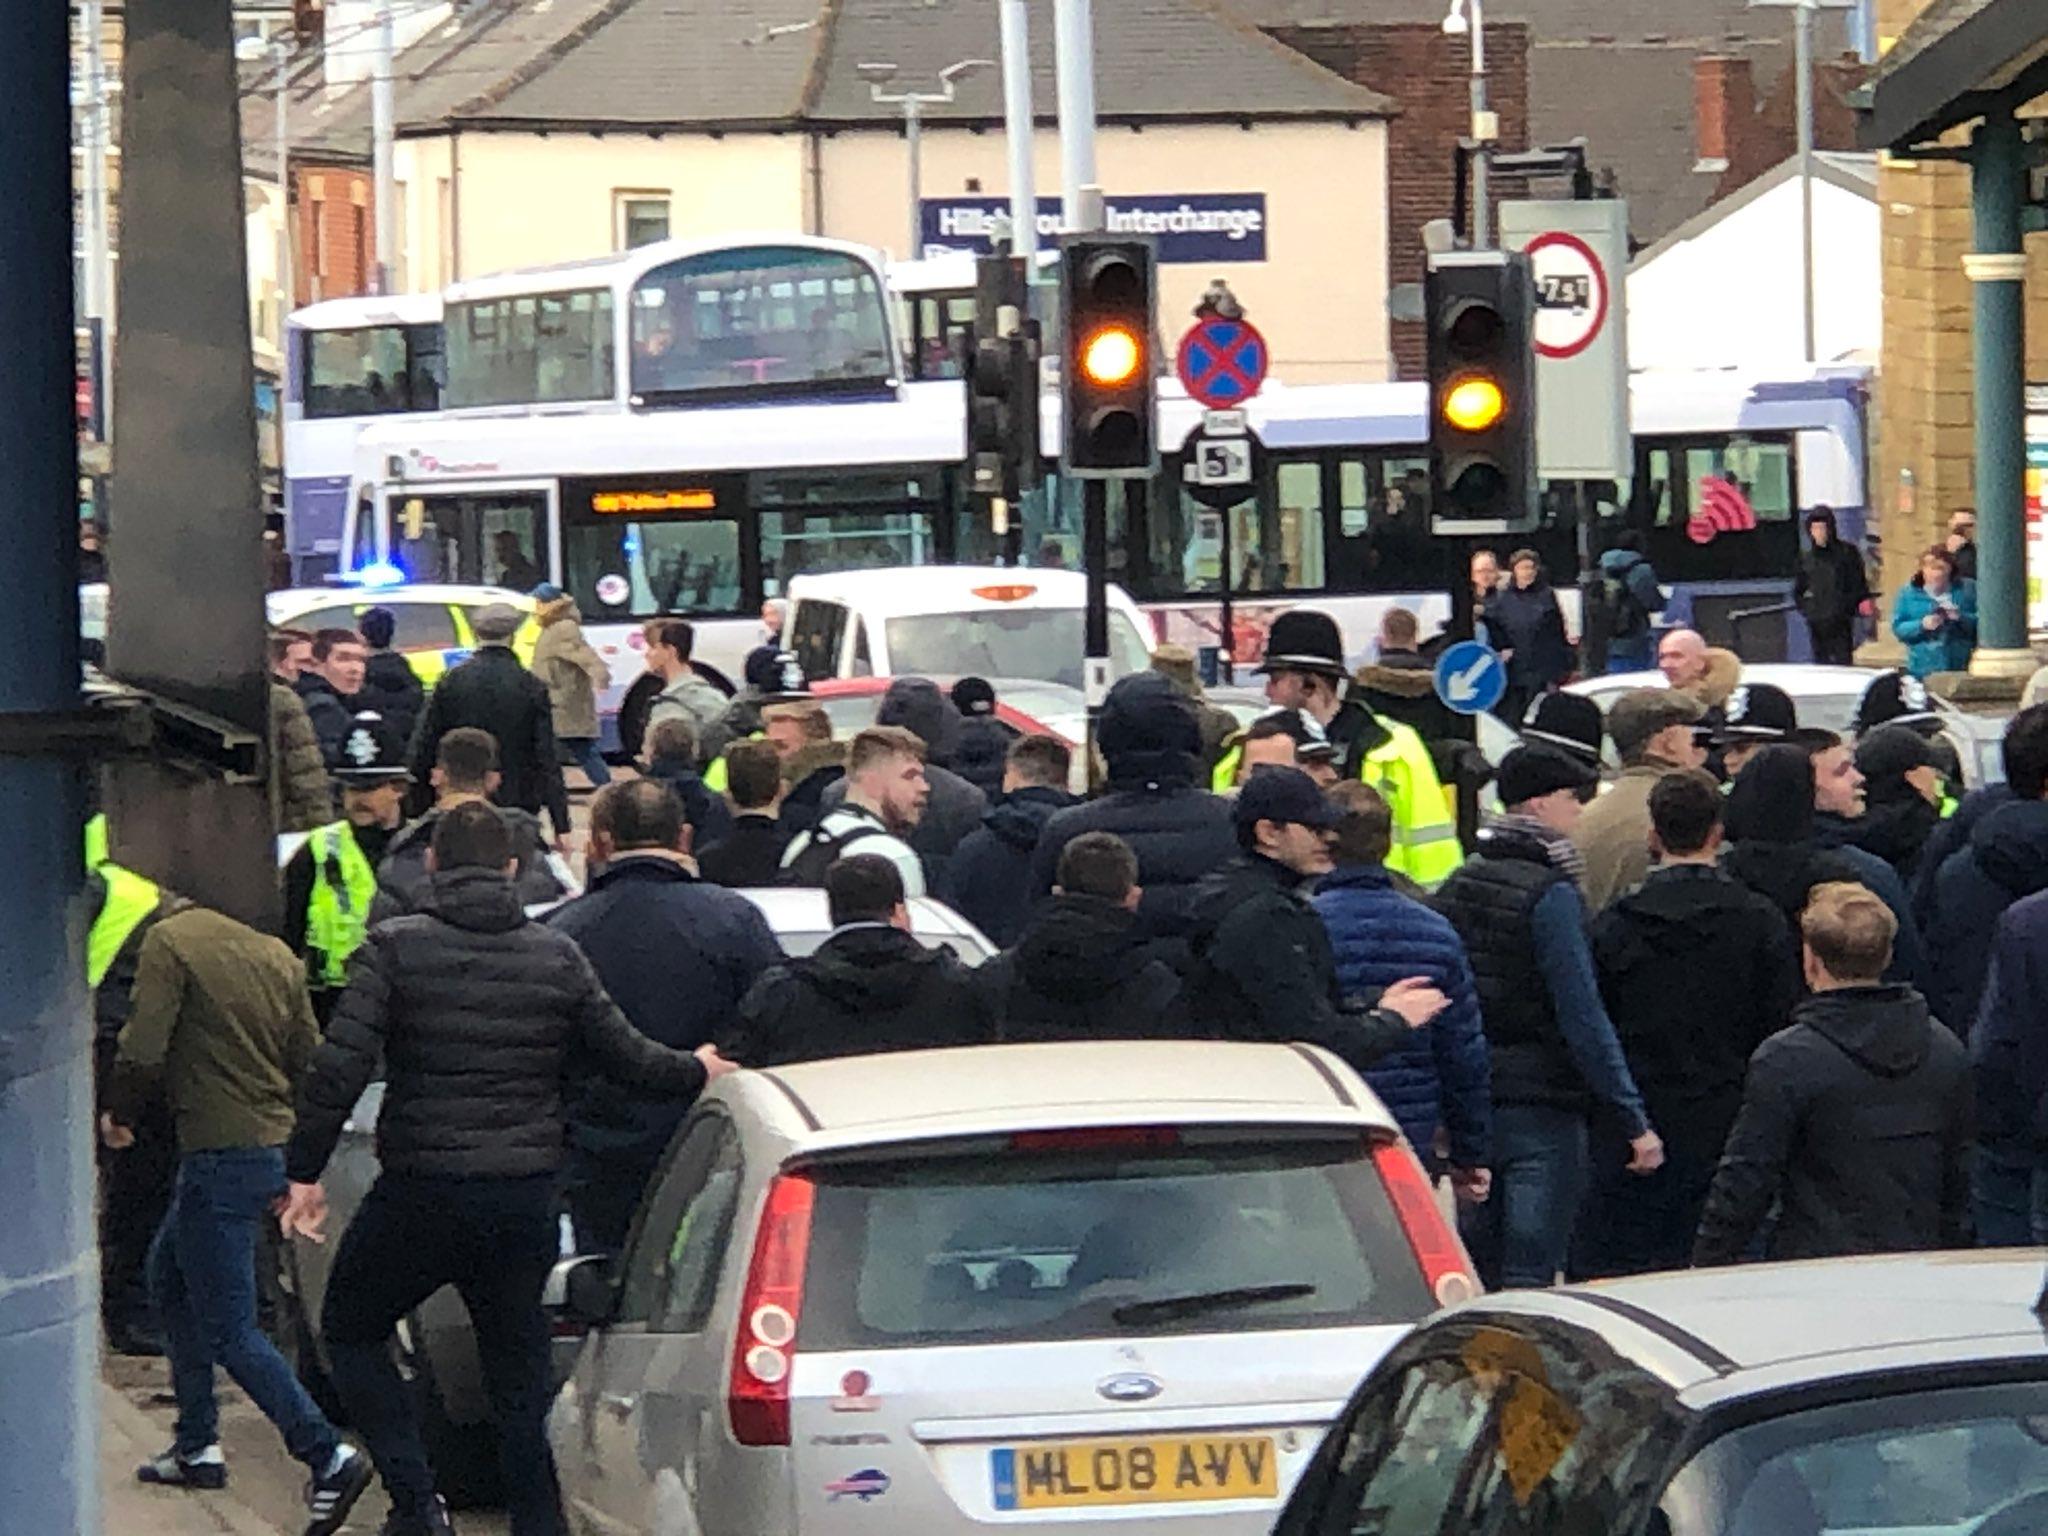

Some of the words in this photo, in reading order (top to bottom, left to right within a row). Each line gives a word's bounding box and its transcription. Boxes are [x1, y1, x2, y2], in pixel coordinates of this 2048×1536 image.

[1106, 203, 1262, 240] Interchange
[1024, 1446, 1157, 1496] ML08
[1174, 1440, 1267, 1489] AVV
